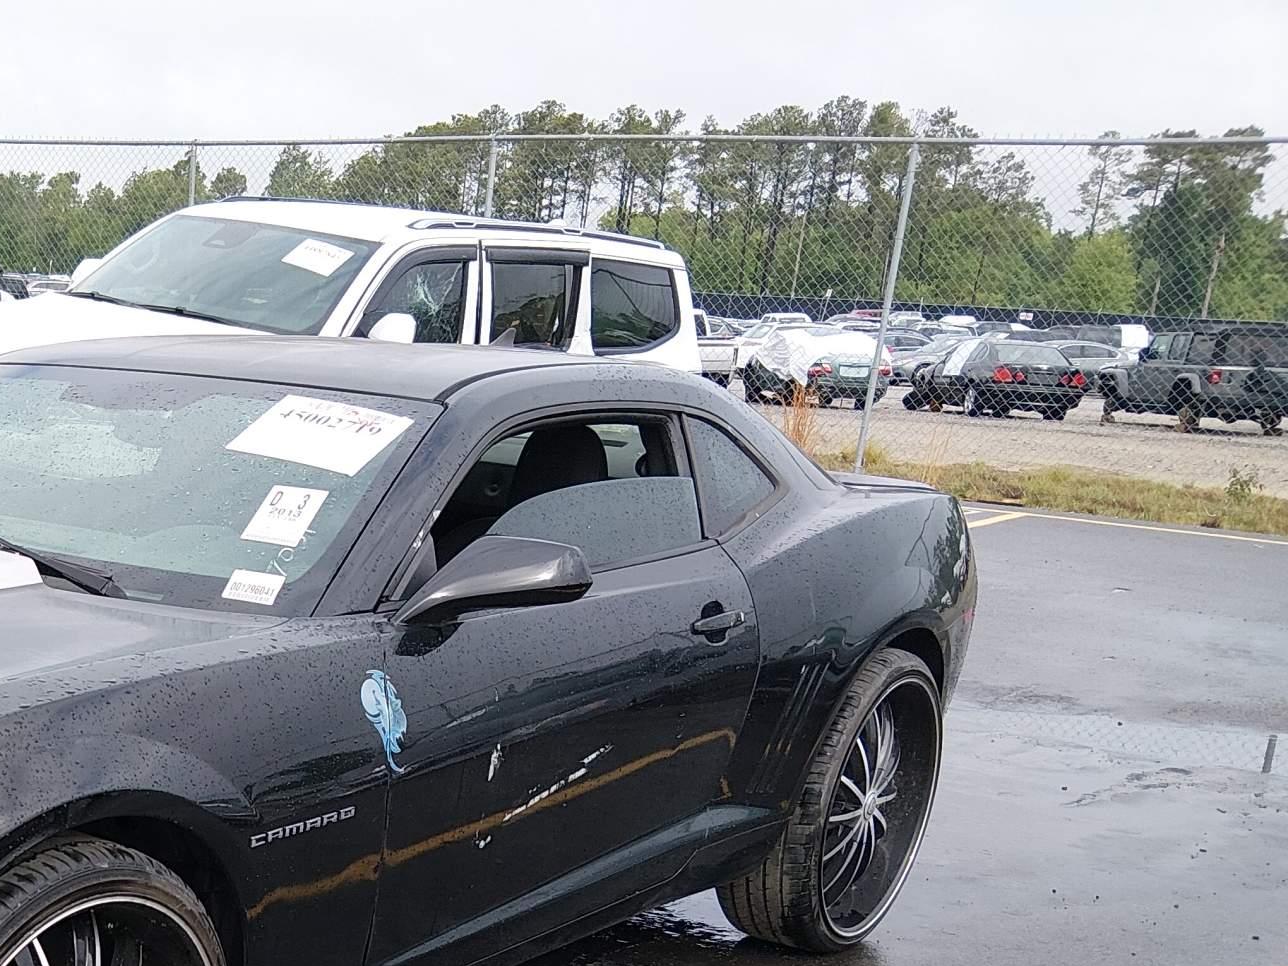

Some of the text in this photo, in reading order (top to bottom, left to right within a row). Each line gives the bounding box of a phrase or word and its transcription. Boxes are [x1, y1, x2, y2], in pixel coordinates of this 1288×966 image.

[279, 408, 383, 436] 45002719
[268, 506, 304, 519] 2013
[297, 493, 311, 511] 3
[249, 805, 357, 849] CAMARO
